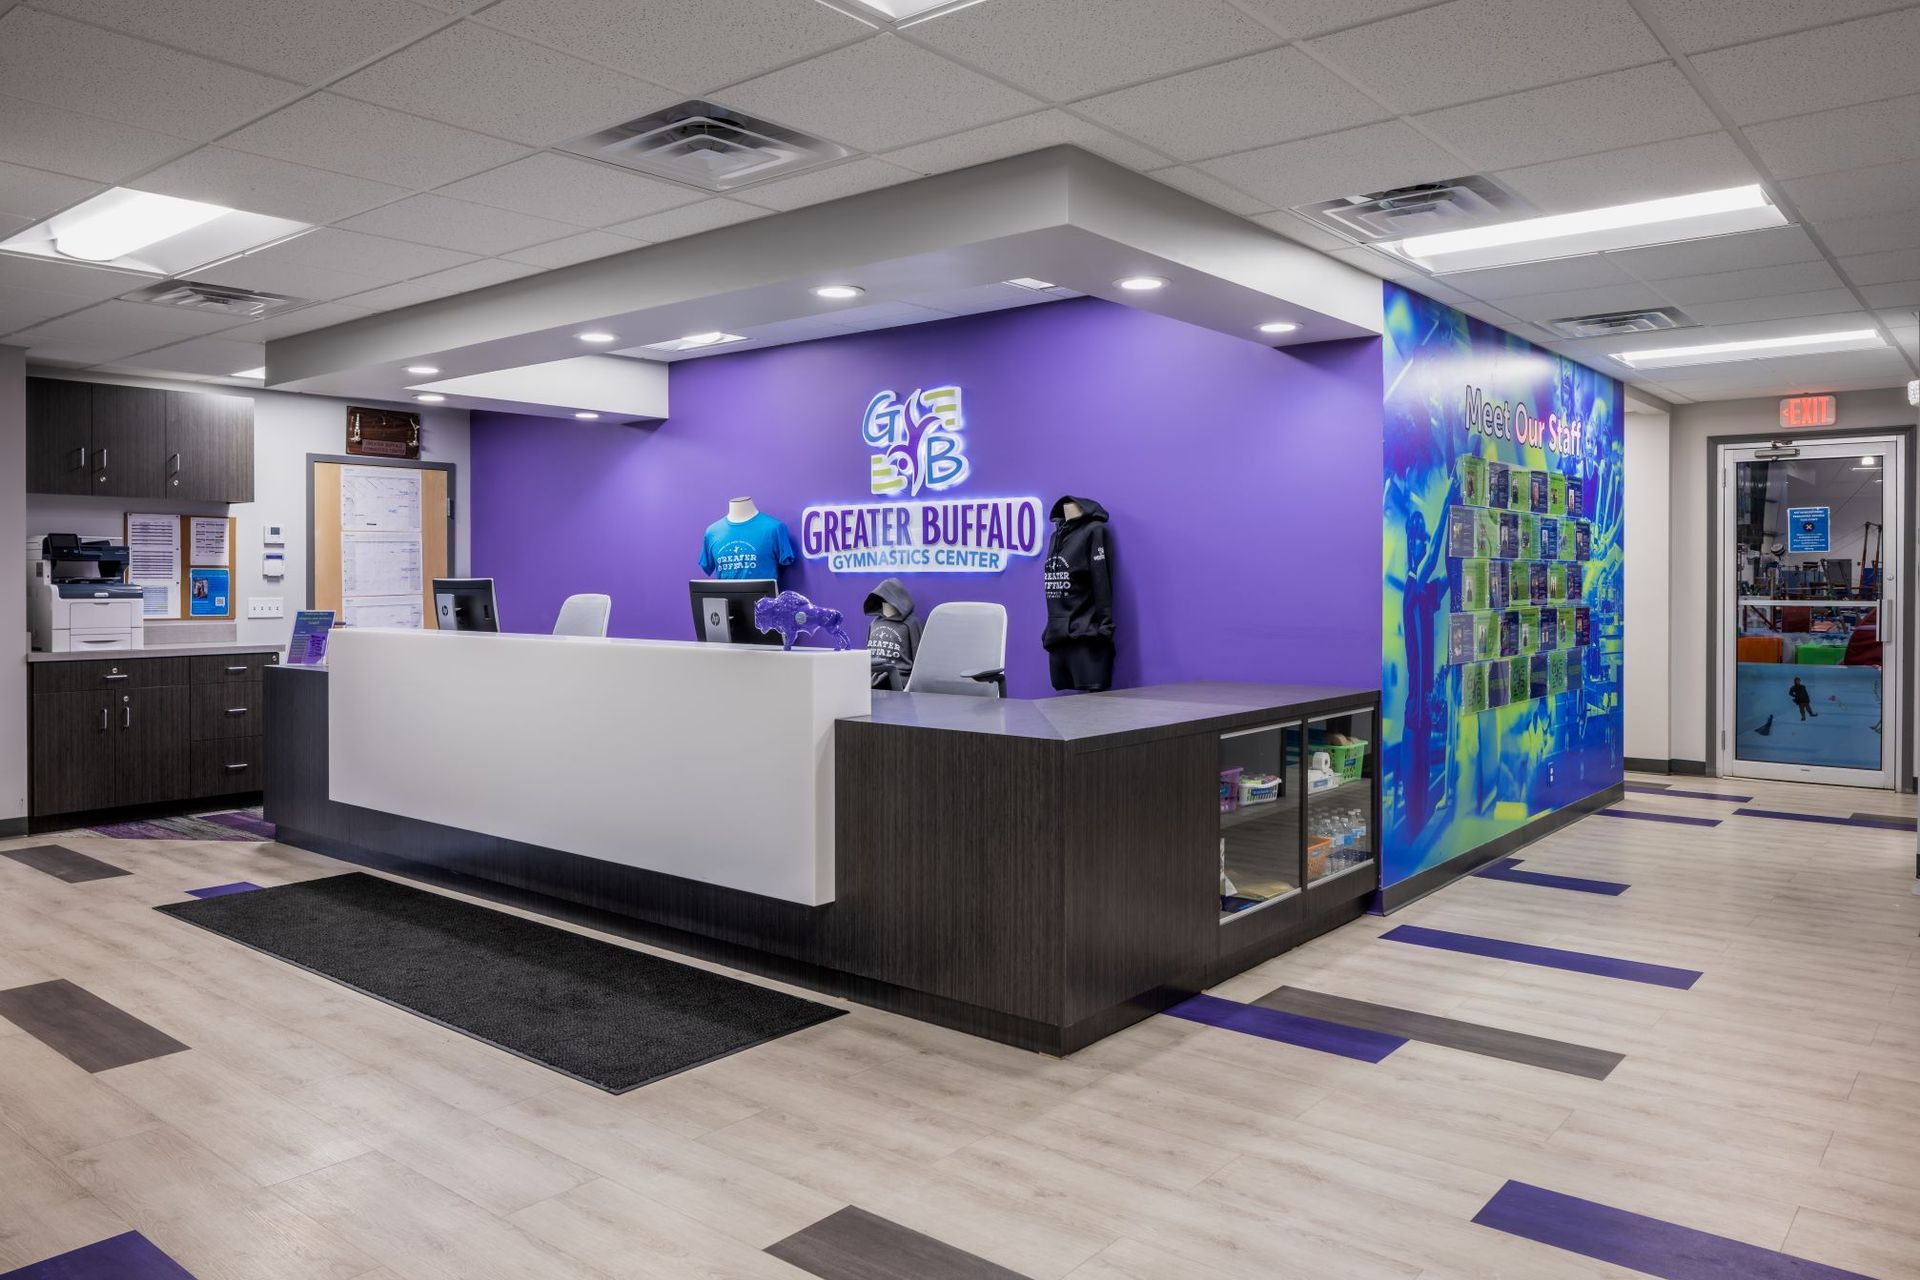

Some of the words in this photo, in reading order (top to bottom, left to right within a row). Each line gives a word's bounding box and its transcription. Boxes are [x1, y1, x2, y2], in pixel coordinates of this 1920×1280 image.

[1465, 385, 1511, 441] Meet
[1514, 401, 1545, 450] Our
[1548, 413, 1583, 456] Staff
[1790, 395, 1829, 425] EXIT
[803, 507, 912, 555] GREATER
[922, 501, 1036, 553] BUFFALO
[833, 549, 930, 570] GYMNASTICS
[934, 549, 1000, 569] CENTER
[867, 639, 901, 652] REATER
